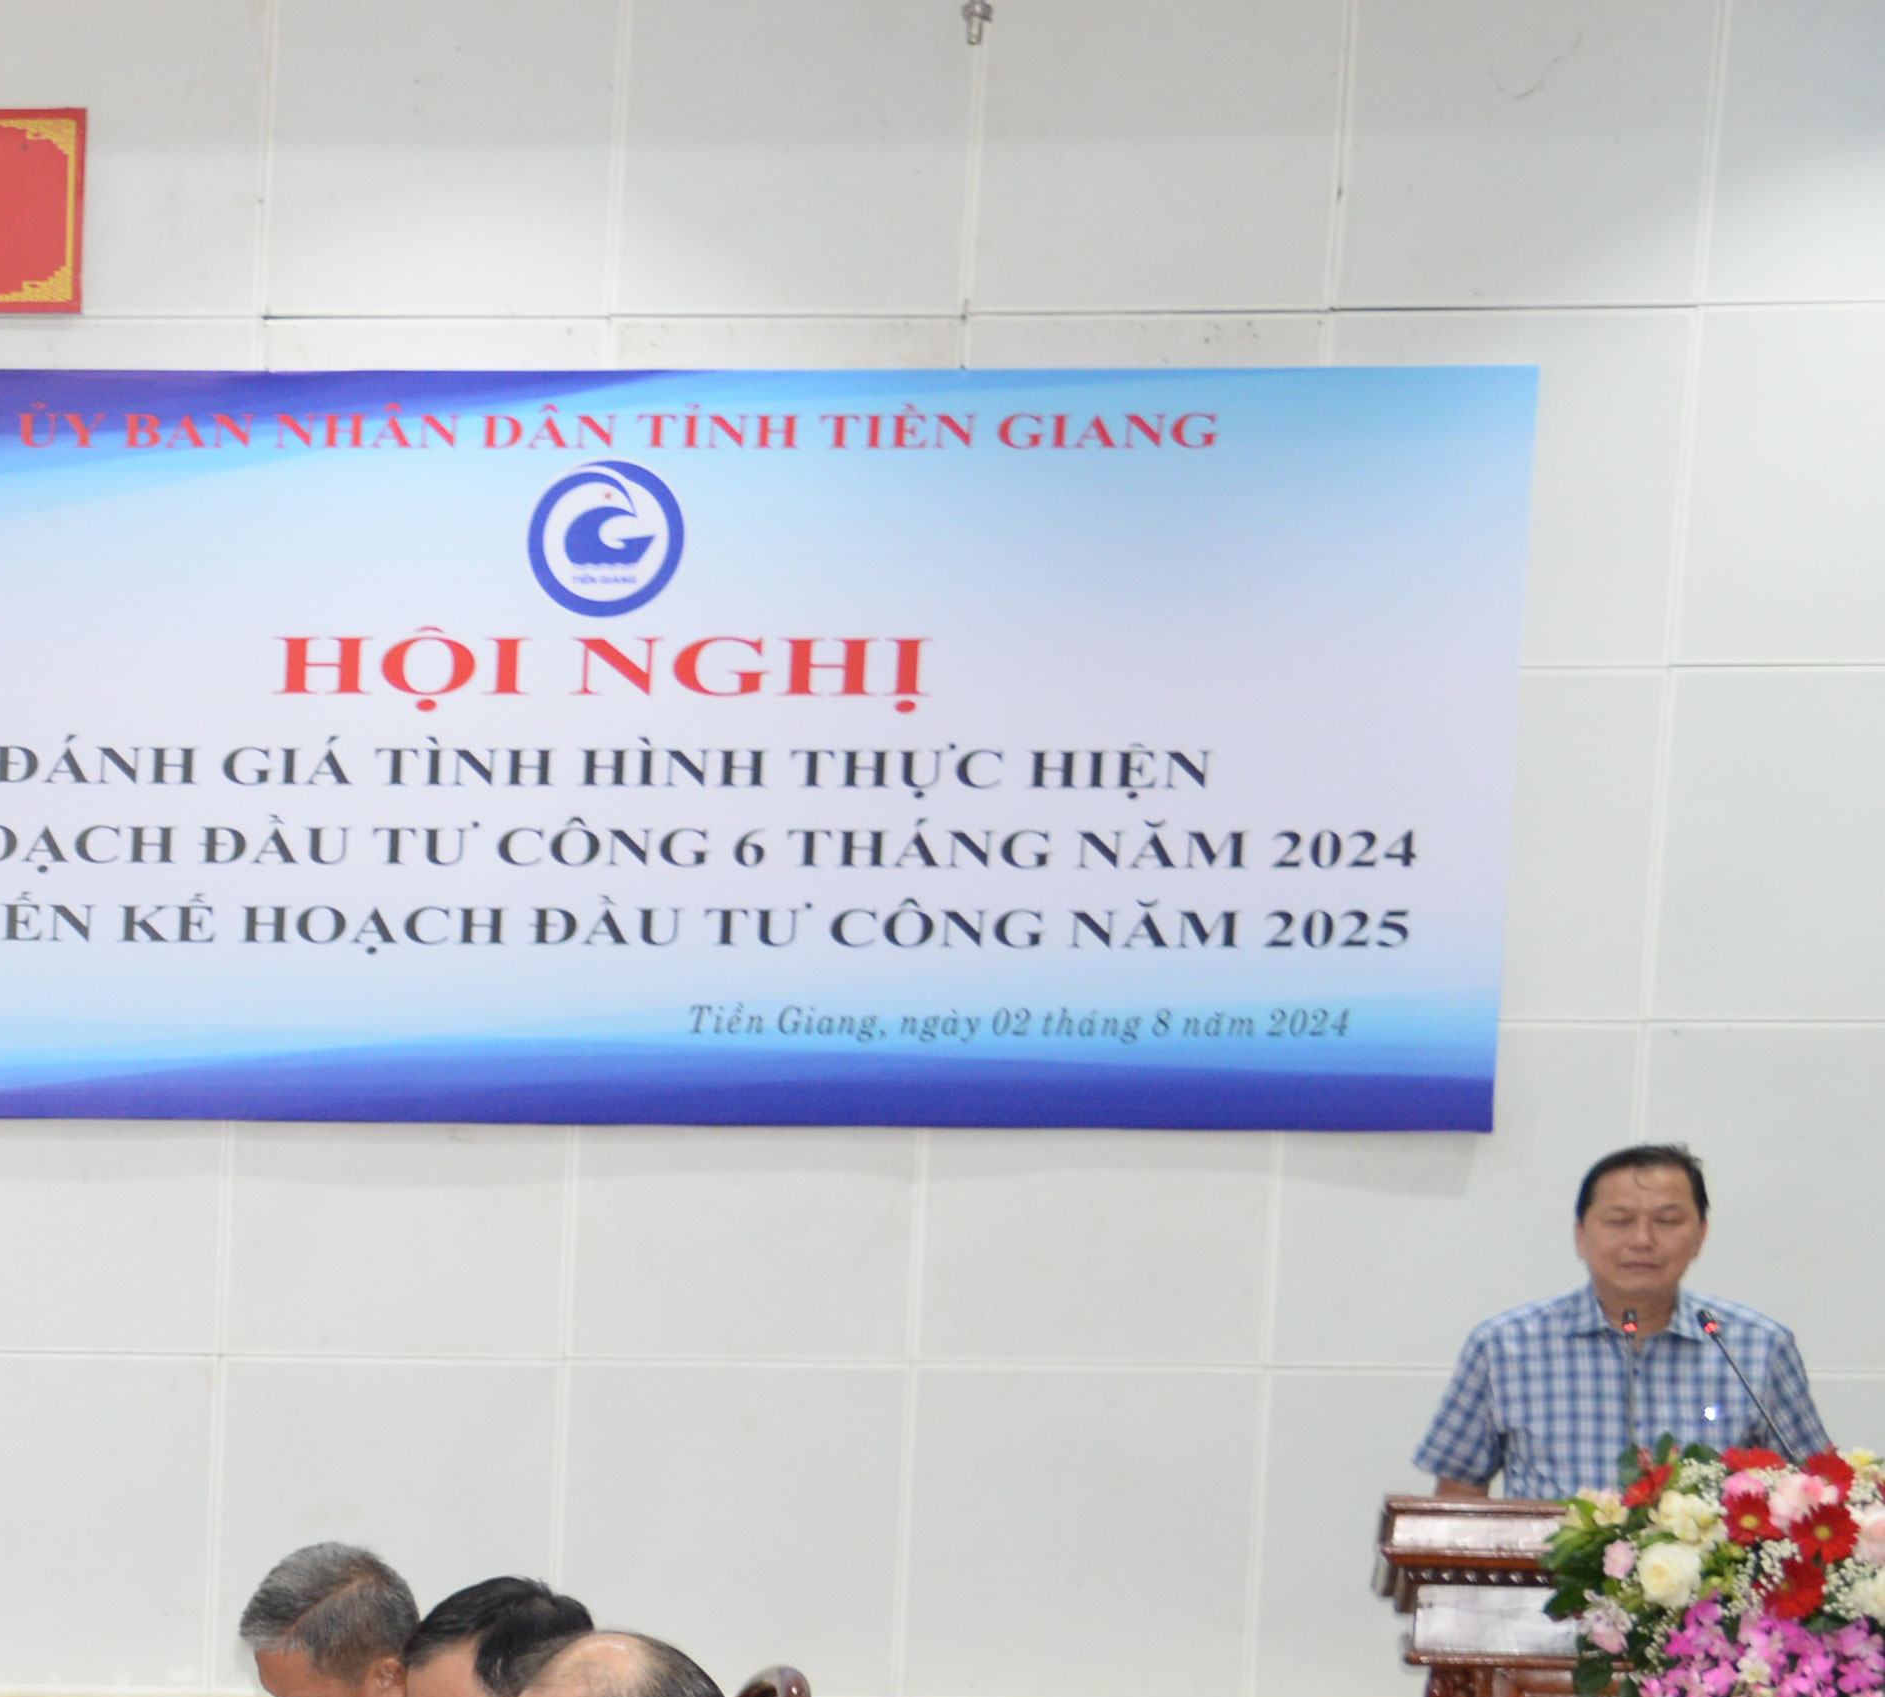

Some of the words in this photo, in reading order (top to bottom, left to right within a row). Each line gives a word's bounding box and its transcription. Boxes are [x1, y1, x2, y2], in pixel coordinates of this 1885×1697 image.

[17, 402, 105, 448] ỦY
[123, 412, 255, 448] BAN
[275, 405, 461, 449] NHÂN
[481, 406, 617, 450] DÂN
[638, 403, 801, 449] TỈNH
[819, 403, 977, 450] TIỀN
[996, 411, 1220, 449] GIANG
[275, 625, 529, 712] HỘI
[571, 636, 933, 714] NGHỊ
[221, 734, 354, 785] GIÁ
[374, 737, 555, 786] TÌNH
[580, 737, 767, 787] HÌNH
[791, 742, 1006, 800] THỰC
[1027, 743, 1213, 801] HIỆN
[200, 815, 357, 865] ĐẦU
[372, 822, 483, 866] TƯ
[496, 817, 711, 867] CÔNG
[732, 828, 767, 867] 6
[788, 820, 1052, 869] THÁNG
[1076, 823, 1248, 869] NĂM
[1270, 828, 1420, 869] 2024
[118, 893, 217, 943] KẾ
[240, 904, 506, 954] HOẠCH
[529, 893, 686, 946] ĐẦU
[703, 904, 816, 947] TƯ
[828, 898, 1045, 948] CÔNG
[1067, 900, 1241, 949] NĂM
[1263, 908, 1412, 949] 2025
[688, 1004, 766, 1036] Tiền
[776, 1005, 890, 1042] Giang,
[900, 1007, 981, 1043] ngày
[990, 1007, 1033, 1037] 02
[1041, 1006, 1143, 1043] tháng
[1151, 1008, 1173, 1037] 8
[1181, 1011, 1256, 1039] năm
[1265, 1007, 1351, 1039] 2024
